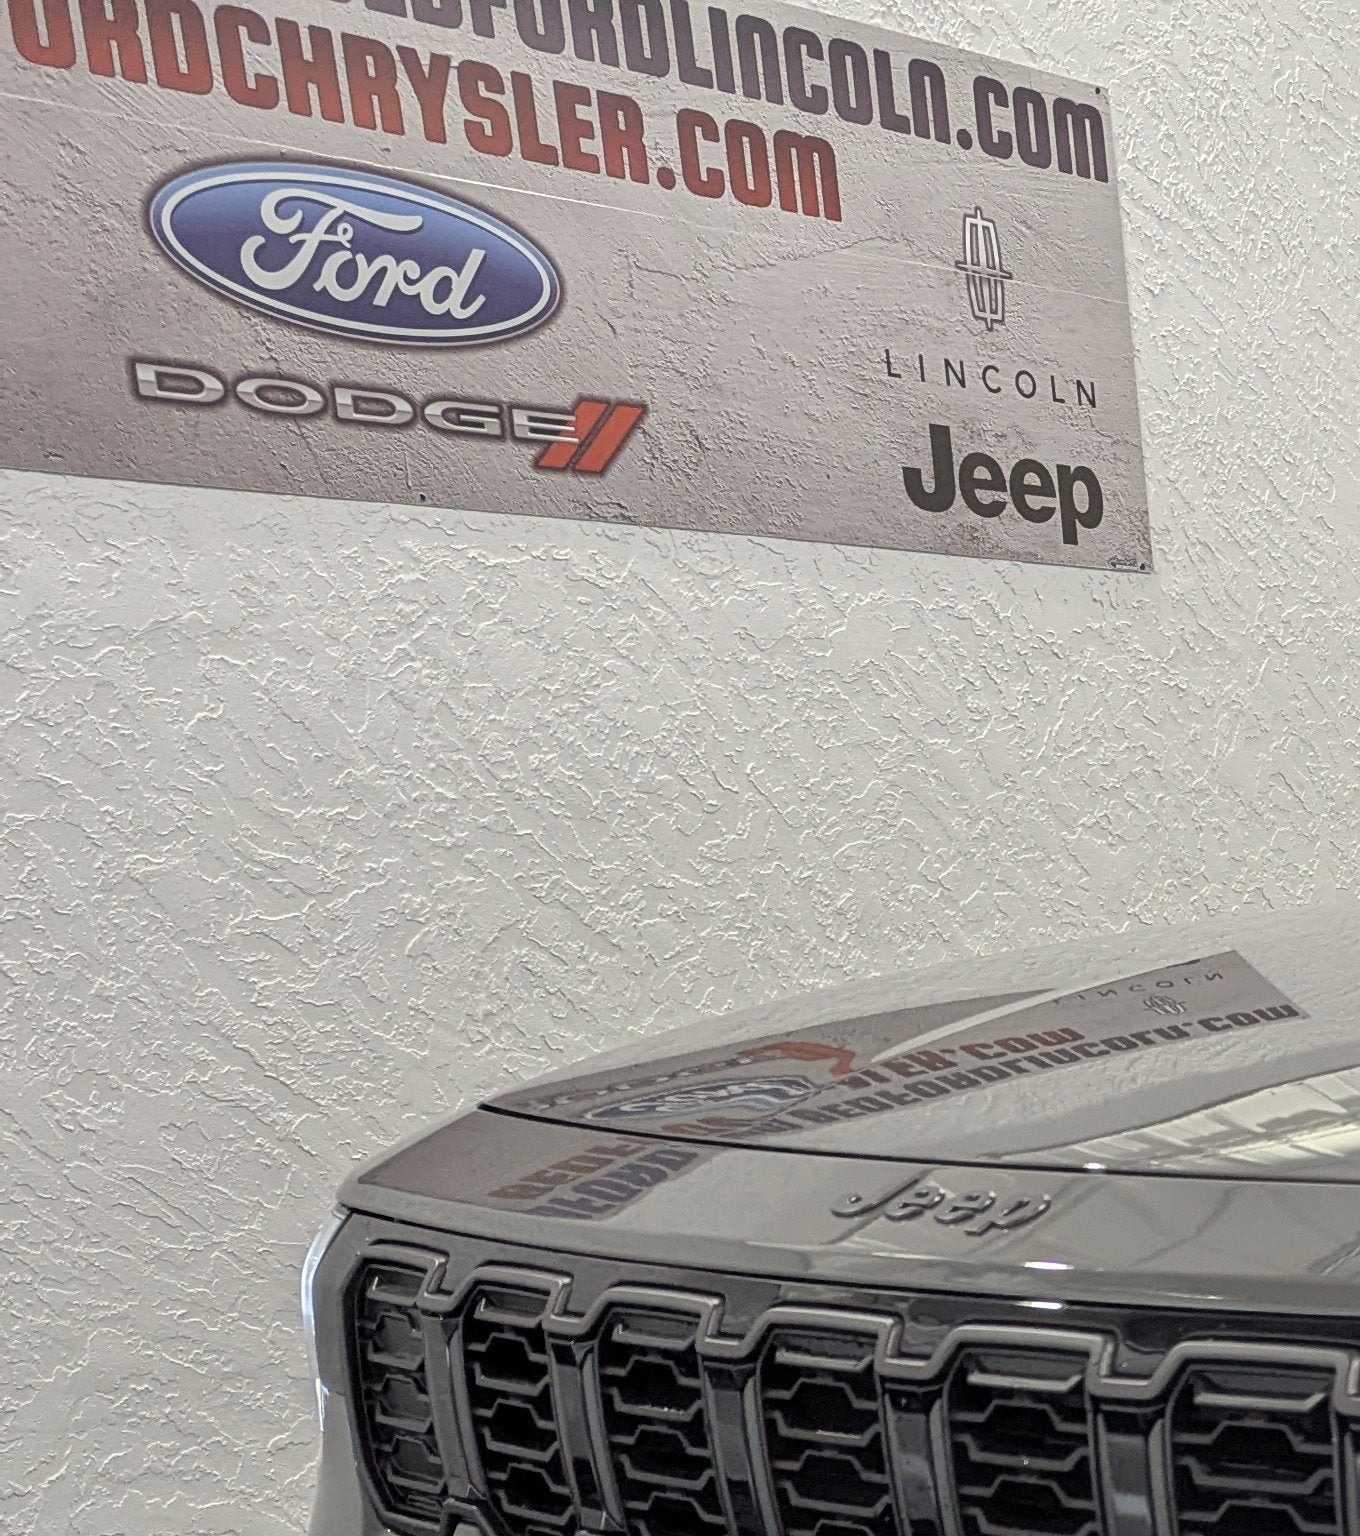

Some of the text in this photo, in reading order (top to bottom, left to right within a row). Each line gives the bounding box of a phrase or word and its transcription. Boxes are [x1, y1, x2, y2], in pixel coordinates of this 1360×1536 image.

[240, 187, 487, 320] Ford
[134, 362, 580, 444] DODGE
[884, 348, 1097, 409] LINCOLN
[901, 423, 1104, 546] Jeep
[830, 1167, 1053, 1238] Jeep
